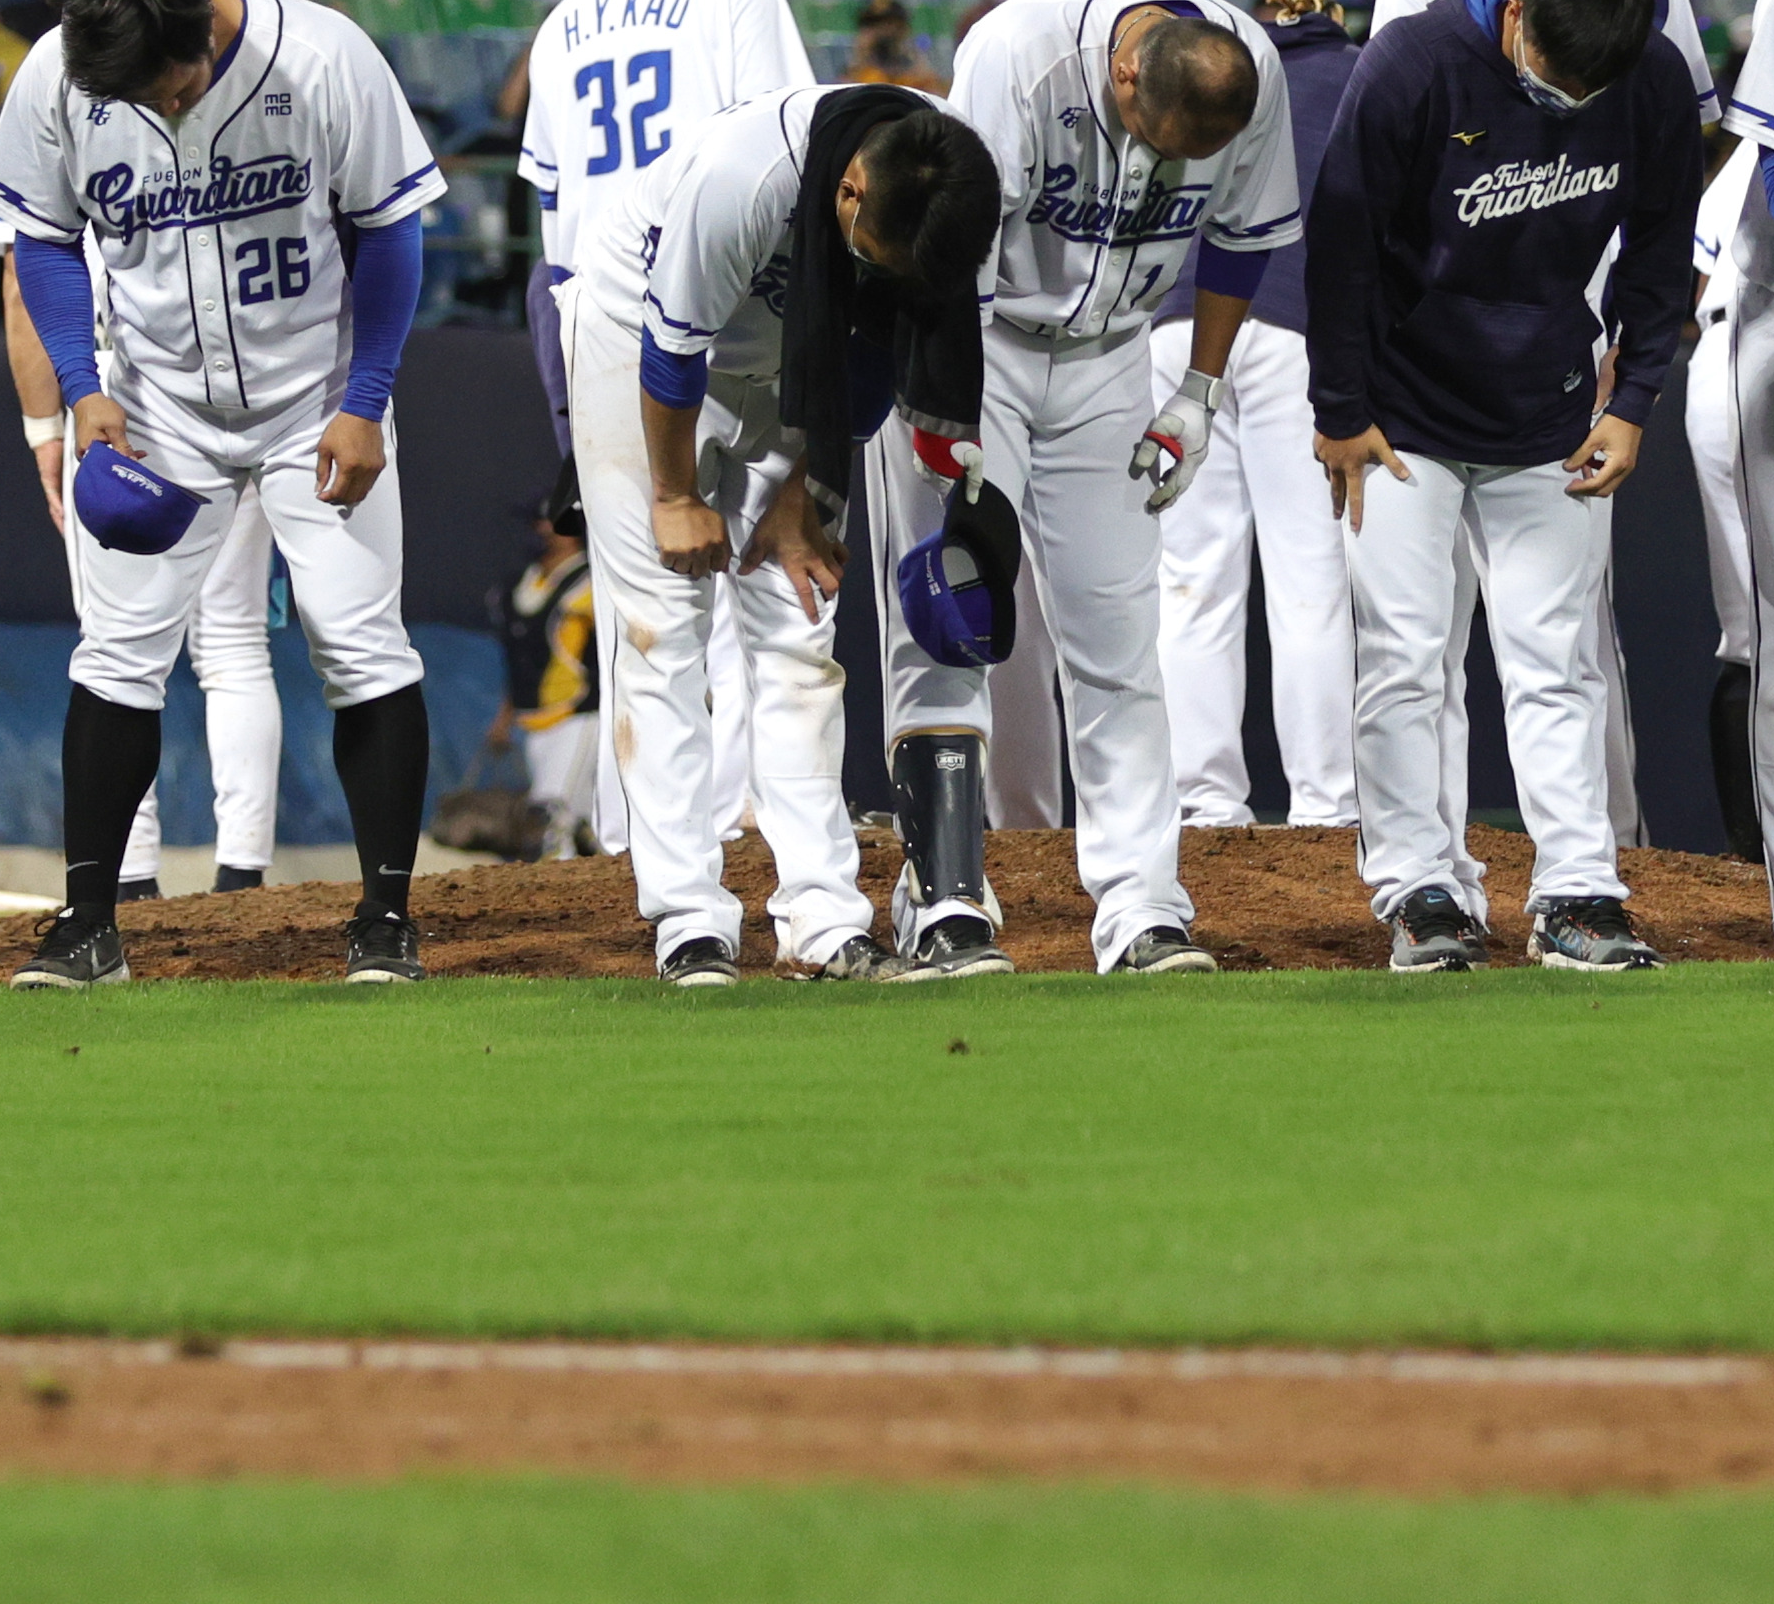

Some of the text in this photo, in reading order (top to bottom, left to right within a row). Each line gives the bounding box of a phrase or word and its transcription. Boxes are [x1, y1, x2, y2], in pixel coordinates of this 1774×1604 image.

[574, 49, 672, 176] 32
[85, 156, 315, 246] Guardians
[142, 166, 203, 188] FUBON
[1452, 152, 1621, 228] Guardians
[1492, 159, 1556, 191] Fubon
[235, 236, 310, 307] 26
